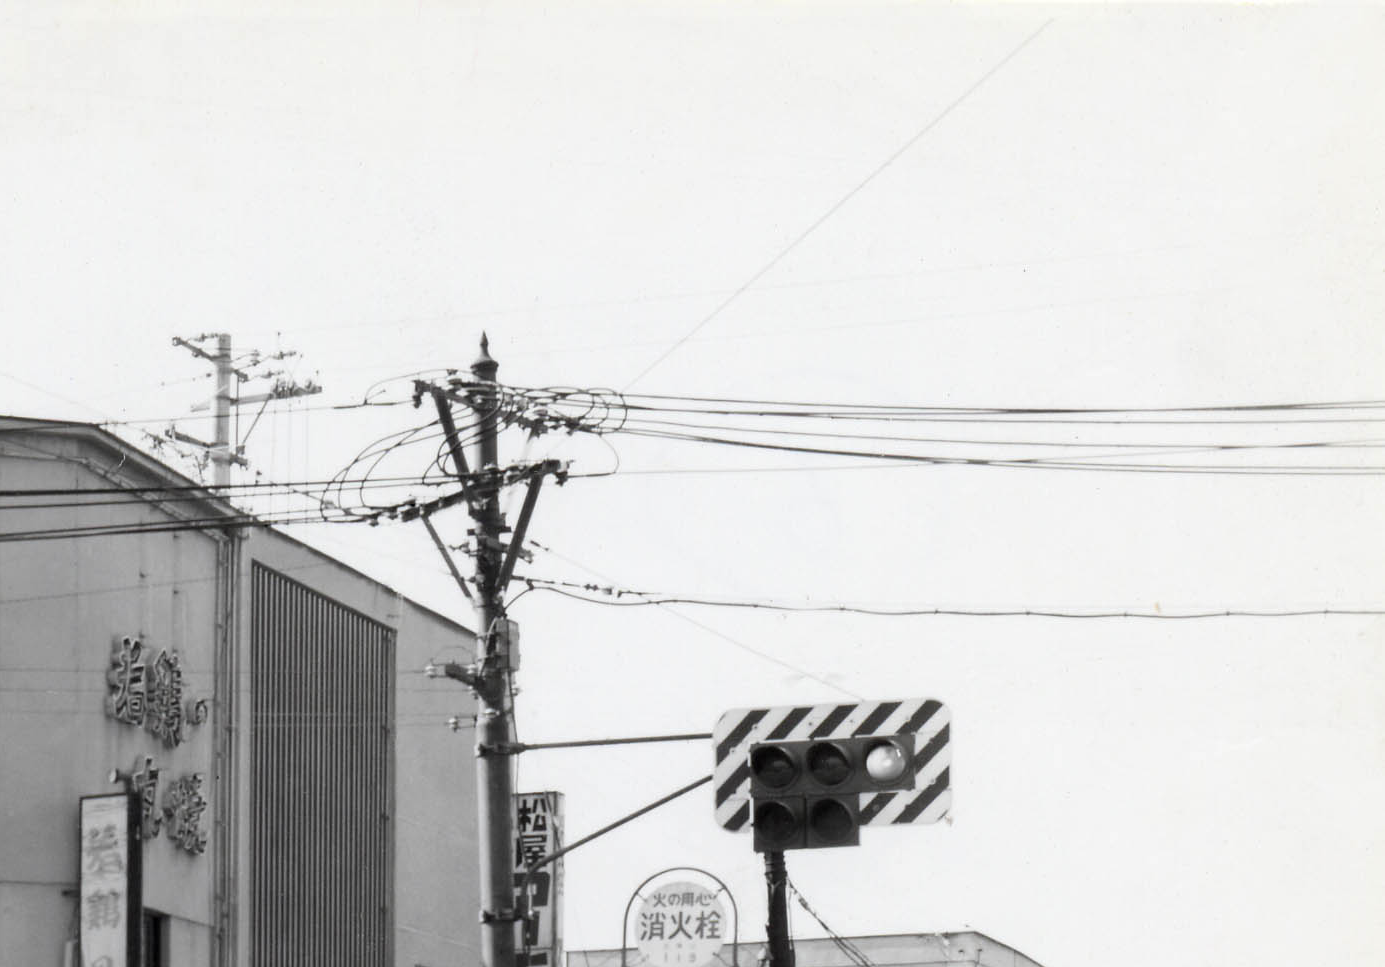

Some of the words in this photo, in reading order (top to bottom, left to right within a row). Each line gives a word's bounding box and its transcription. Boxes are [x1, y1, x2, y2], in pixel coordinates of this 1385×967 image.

[653, 892, 716, 908] 火の用心
[640, 910, 721, 941] 消火栓
